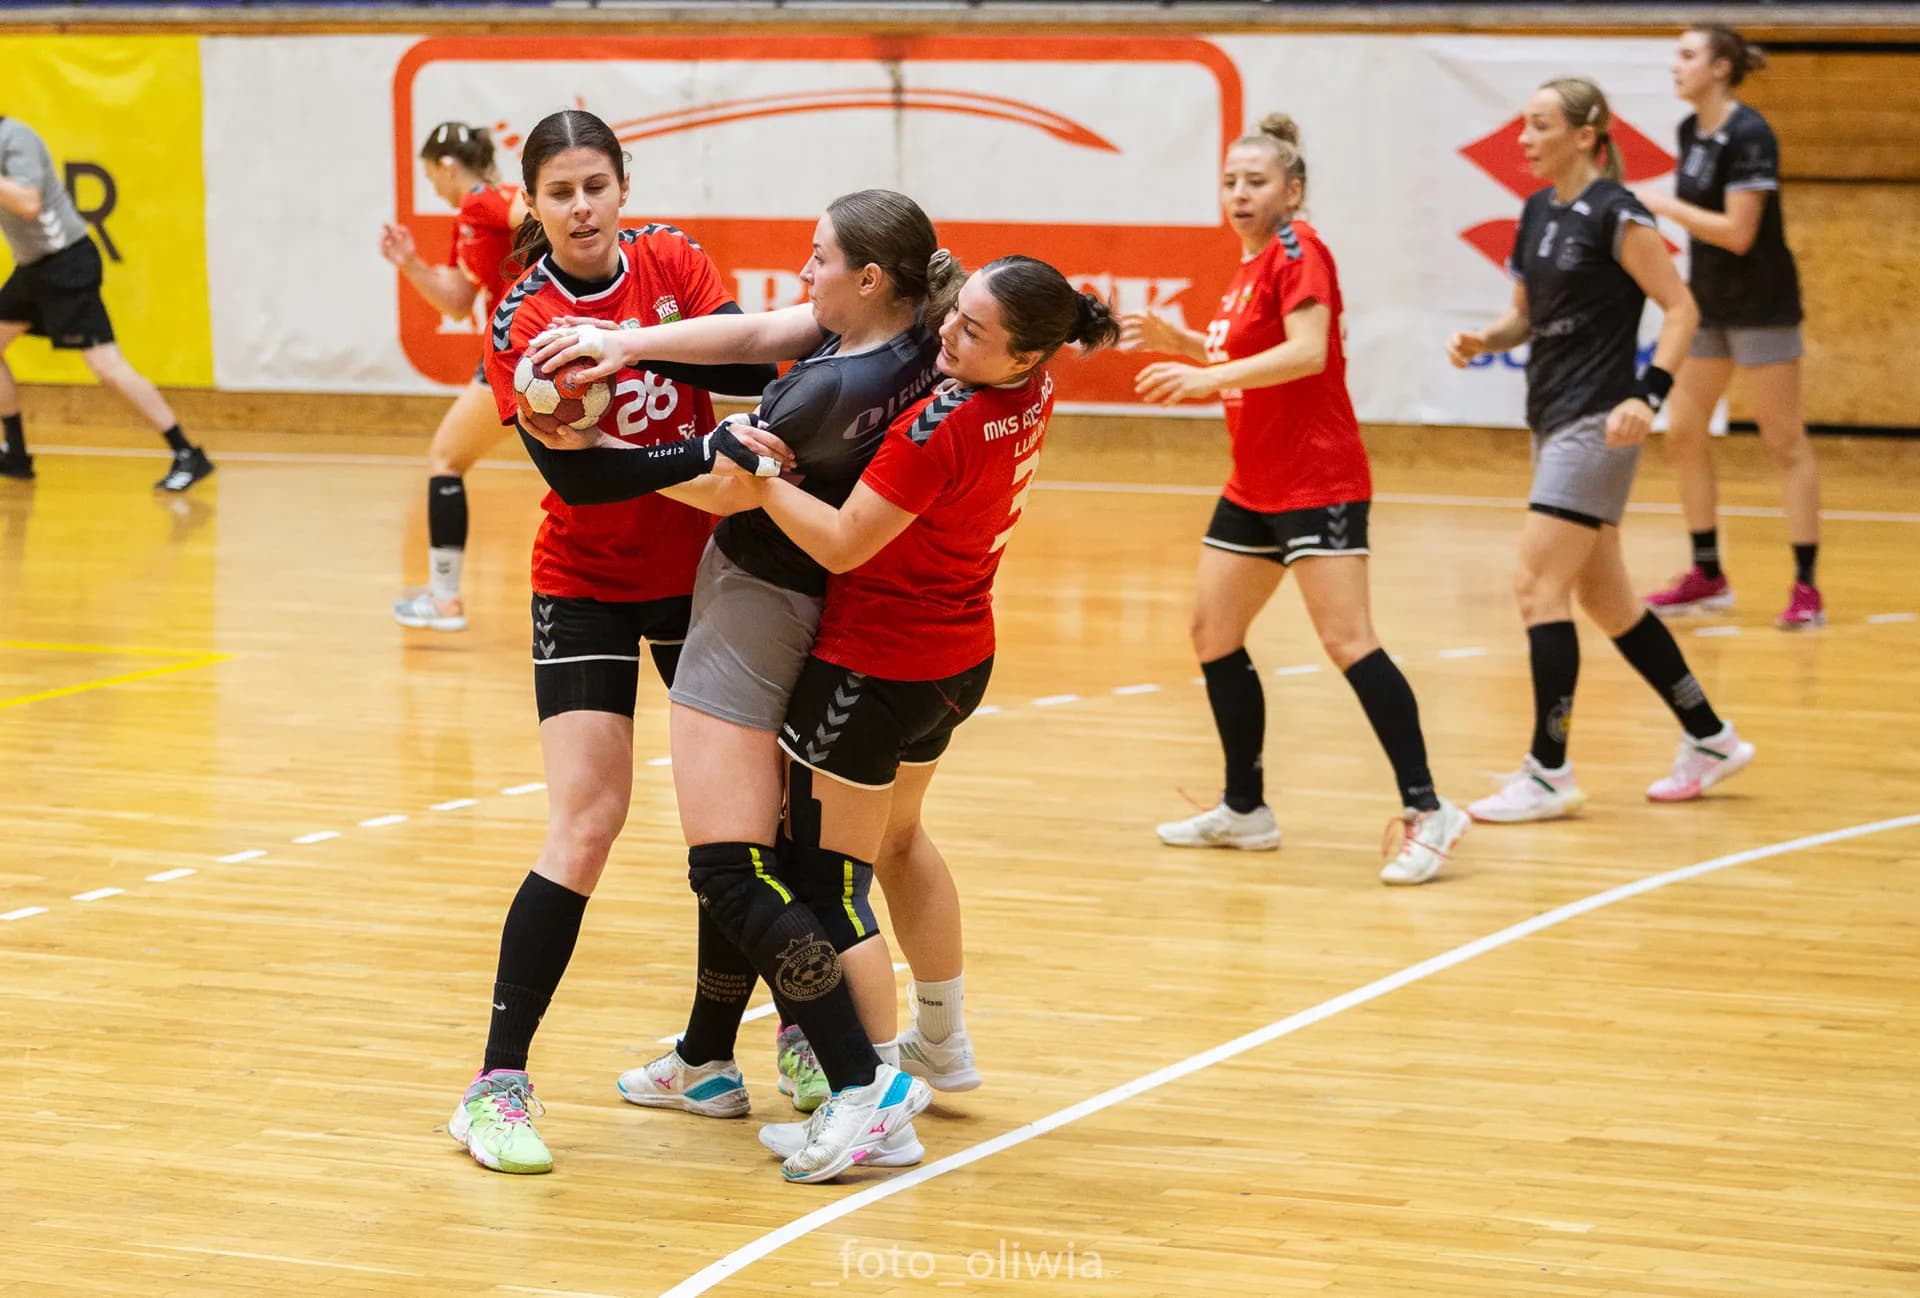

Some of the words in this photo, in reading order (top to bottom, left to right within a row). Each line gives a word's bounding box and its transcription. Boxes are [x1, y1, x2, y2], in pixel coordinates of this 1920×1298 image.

[655, 300, 679, 320] MKS
[616, 370, 679, 436] 28
[983, 415, 1020, 442] MKS
[648, 446, 685, 458] KIPSTA
